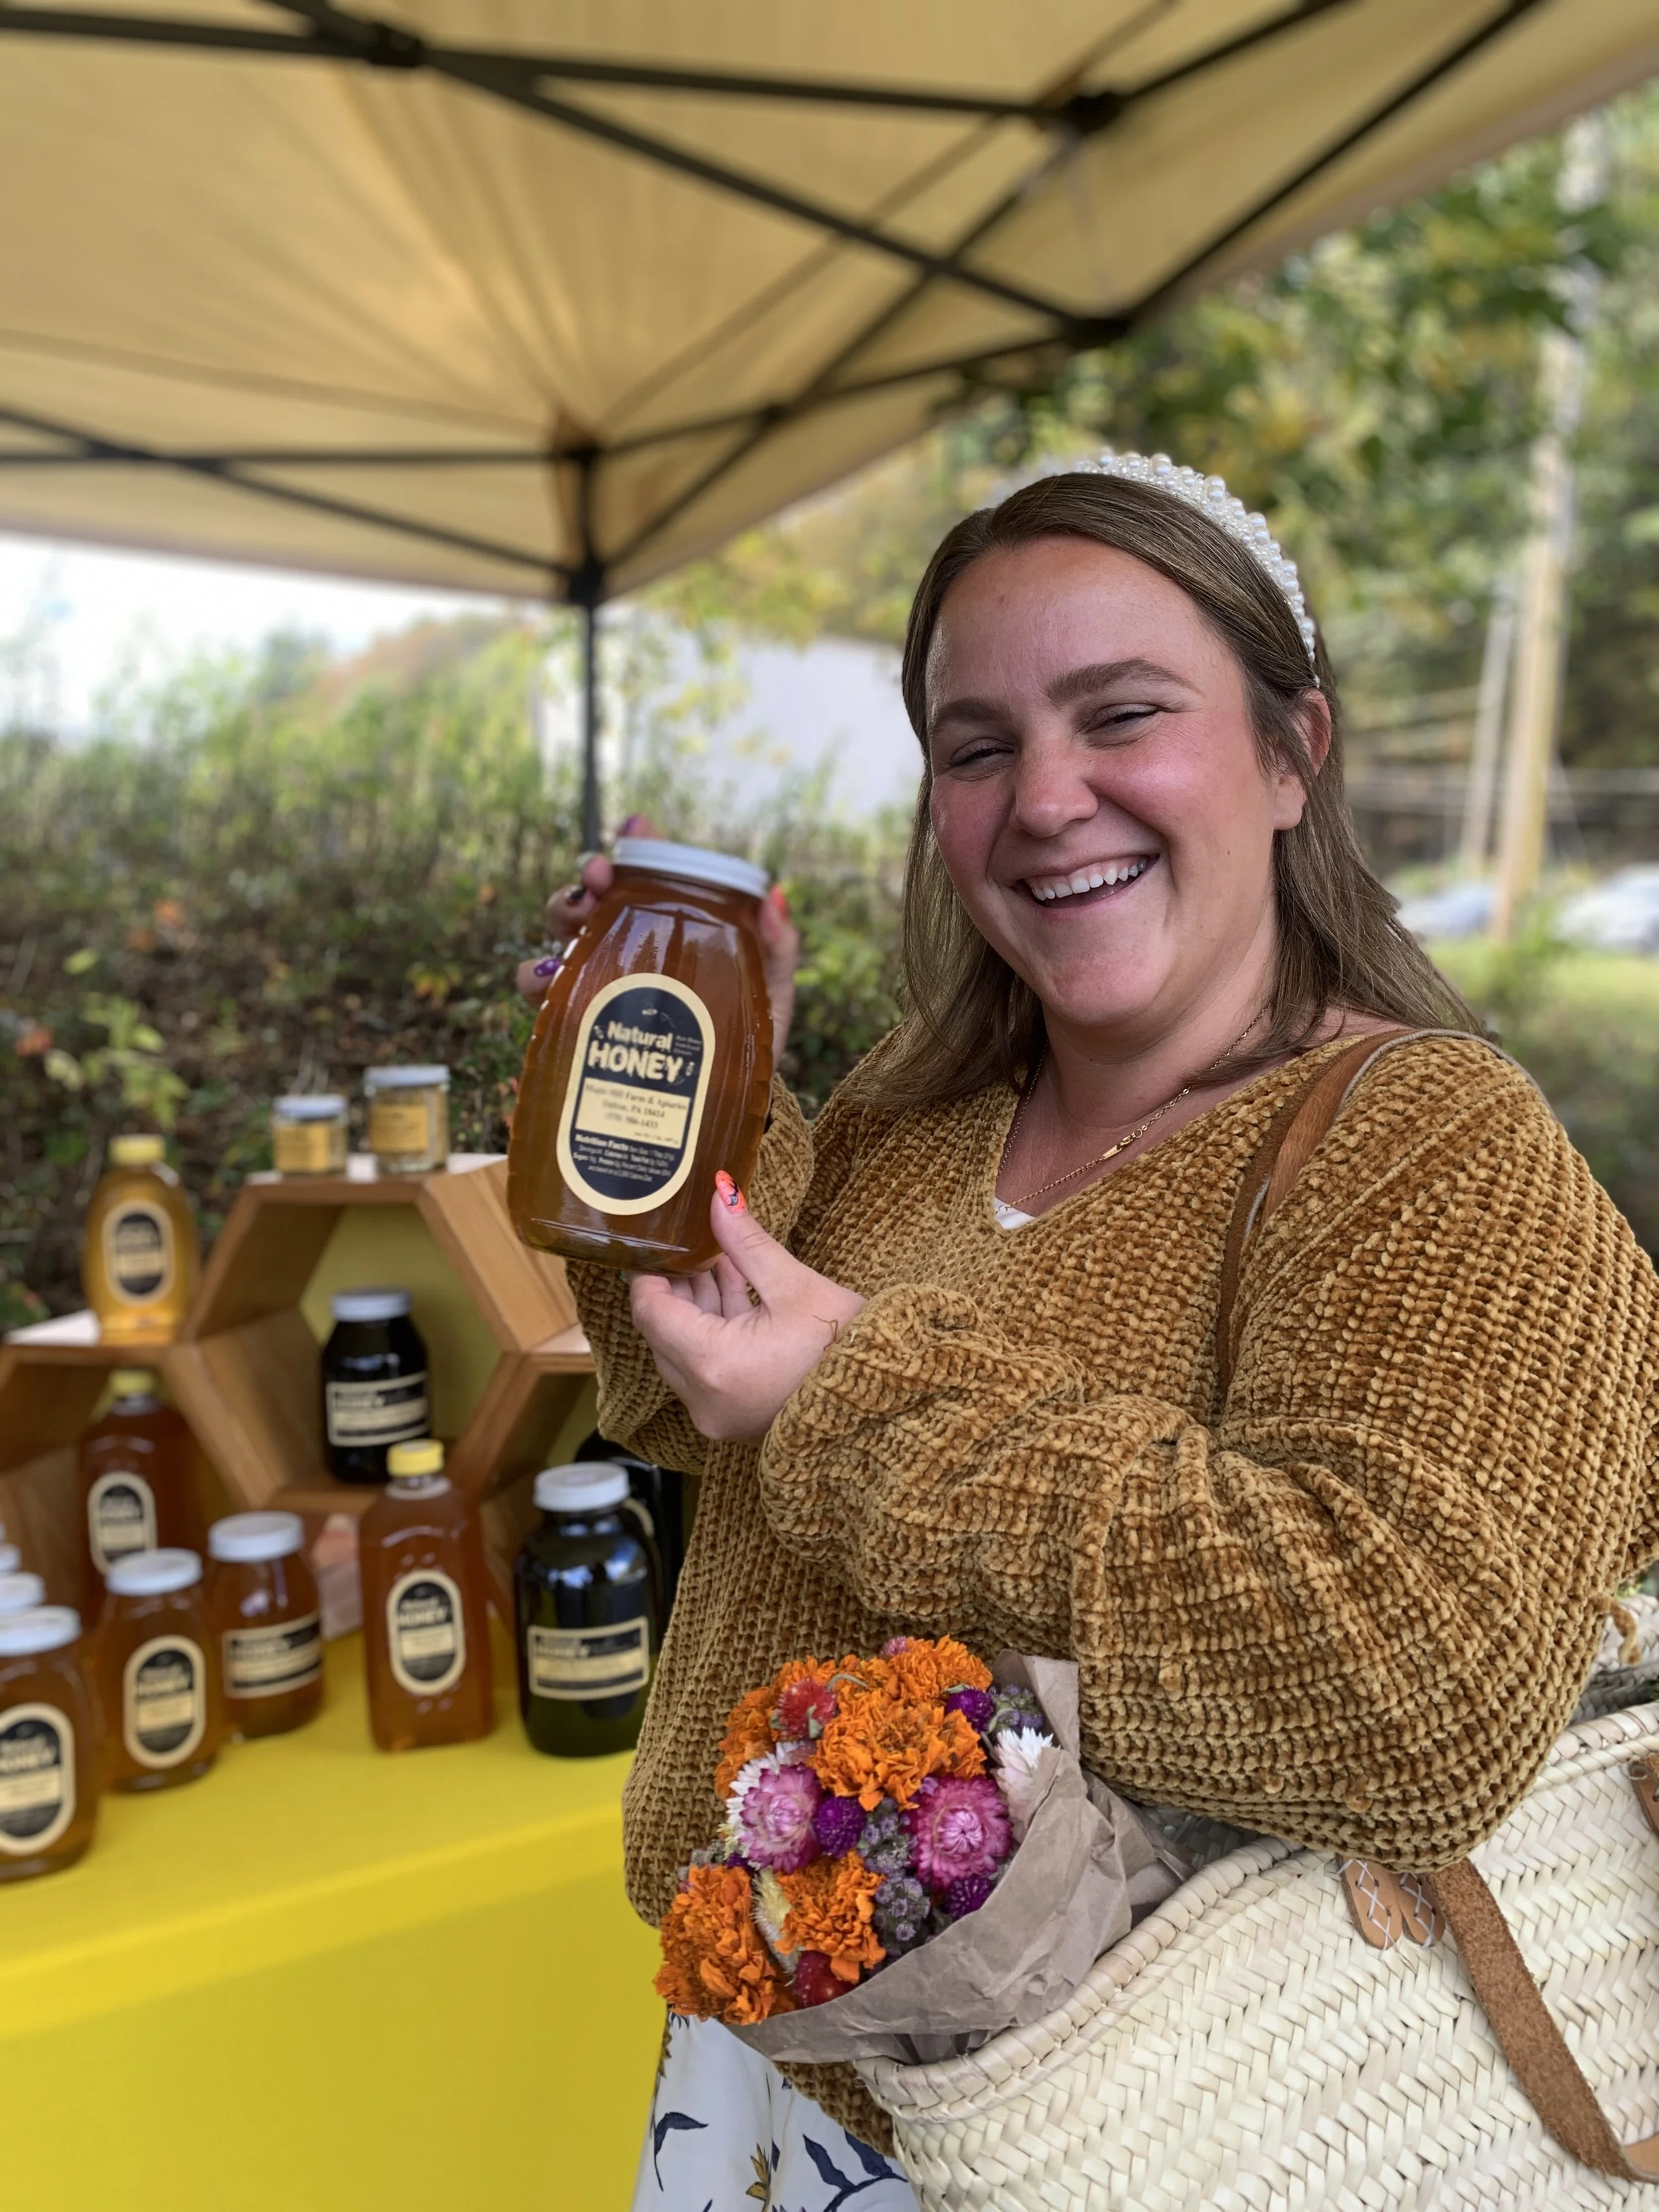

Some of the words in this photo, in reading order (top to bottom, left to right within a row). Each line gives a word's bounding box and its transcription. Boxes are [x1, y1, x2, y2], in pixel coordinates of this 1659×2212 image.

[607, 1020, 674, 1051] Natural
[587, 1039, 684, 1083] HONEY
[625, 1092, 646, 1102] Farm
